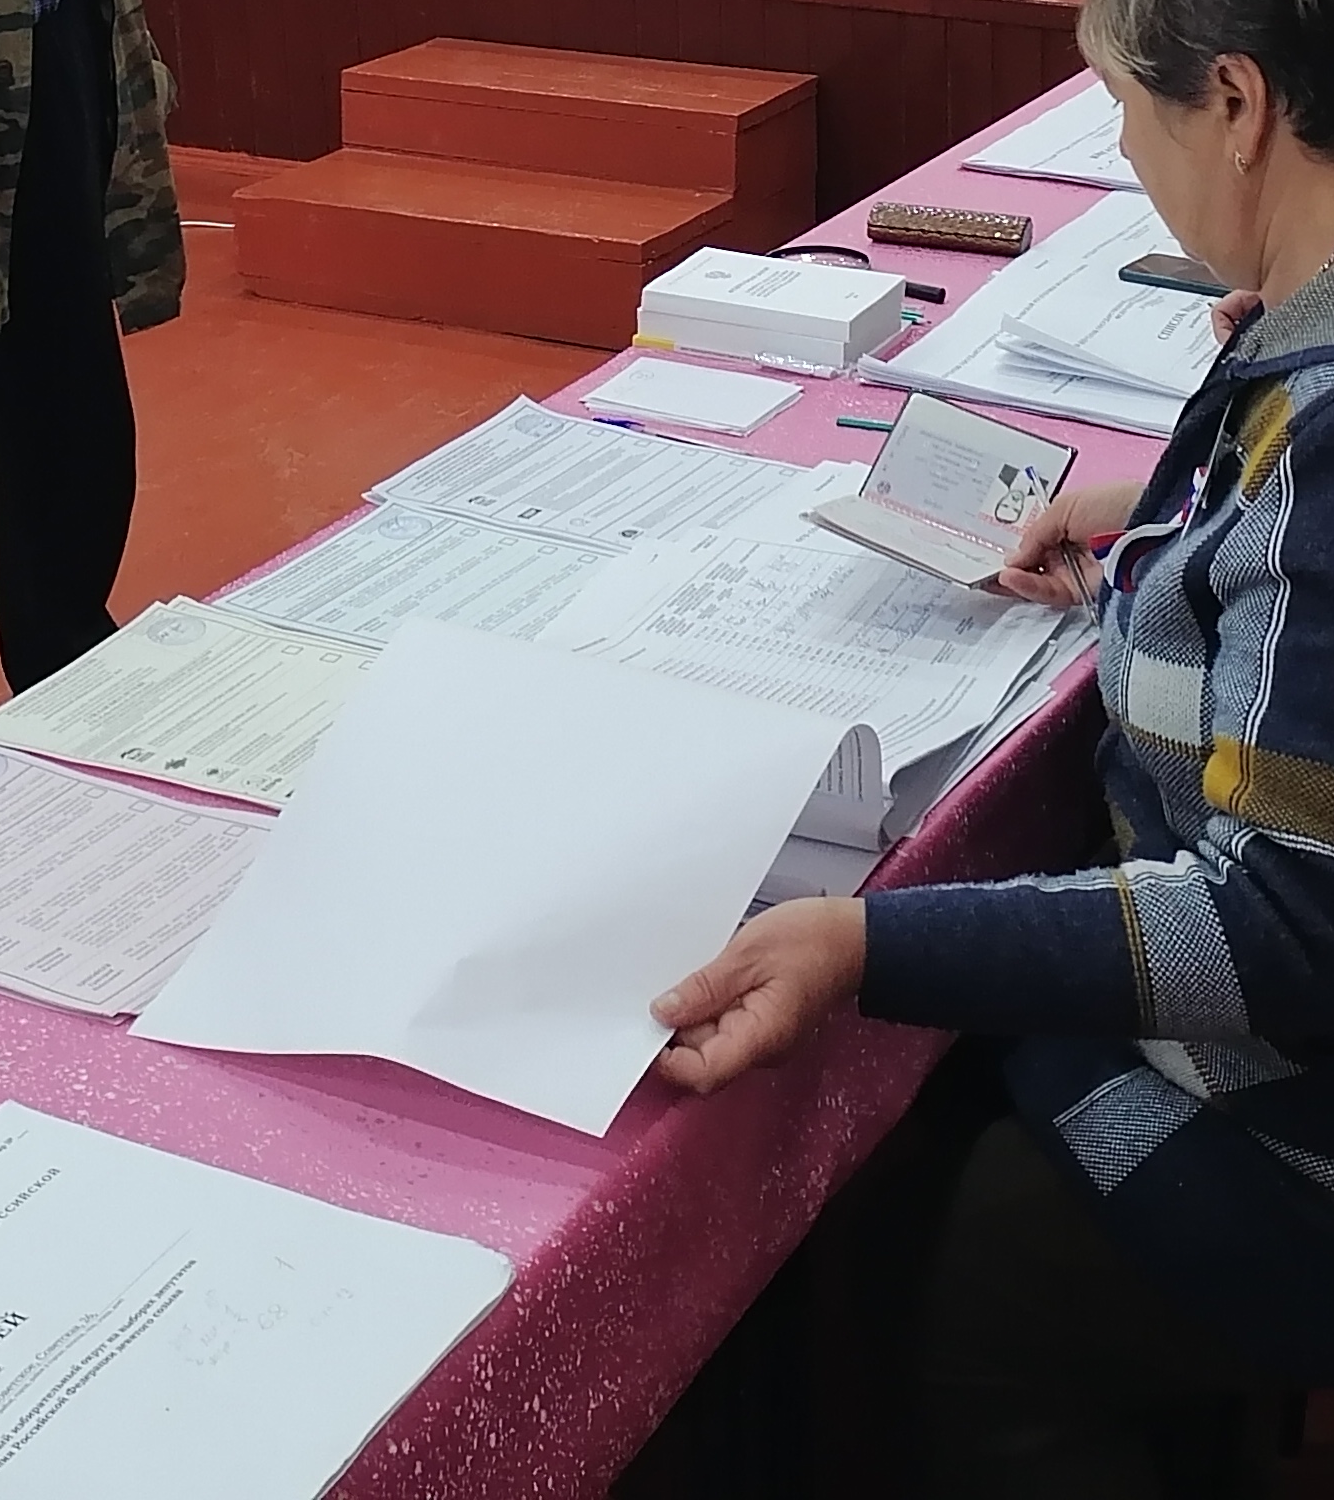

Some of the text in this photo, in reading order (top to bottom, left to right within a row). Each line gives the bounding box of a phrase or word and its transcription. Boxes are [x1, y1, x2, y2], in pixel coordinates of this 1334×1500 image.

[10, 1364, 83, 1435] избирательный
[80, 1342, 108, 1366] округ
[117, 1298, 157, 1333] выборах
[153, 1259, 198, 1300] депутатов
[10, 1393, 70, 1451] Российской
[65, 1351, 118, 1397] Федерации
